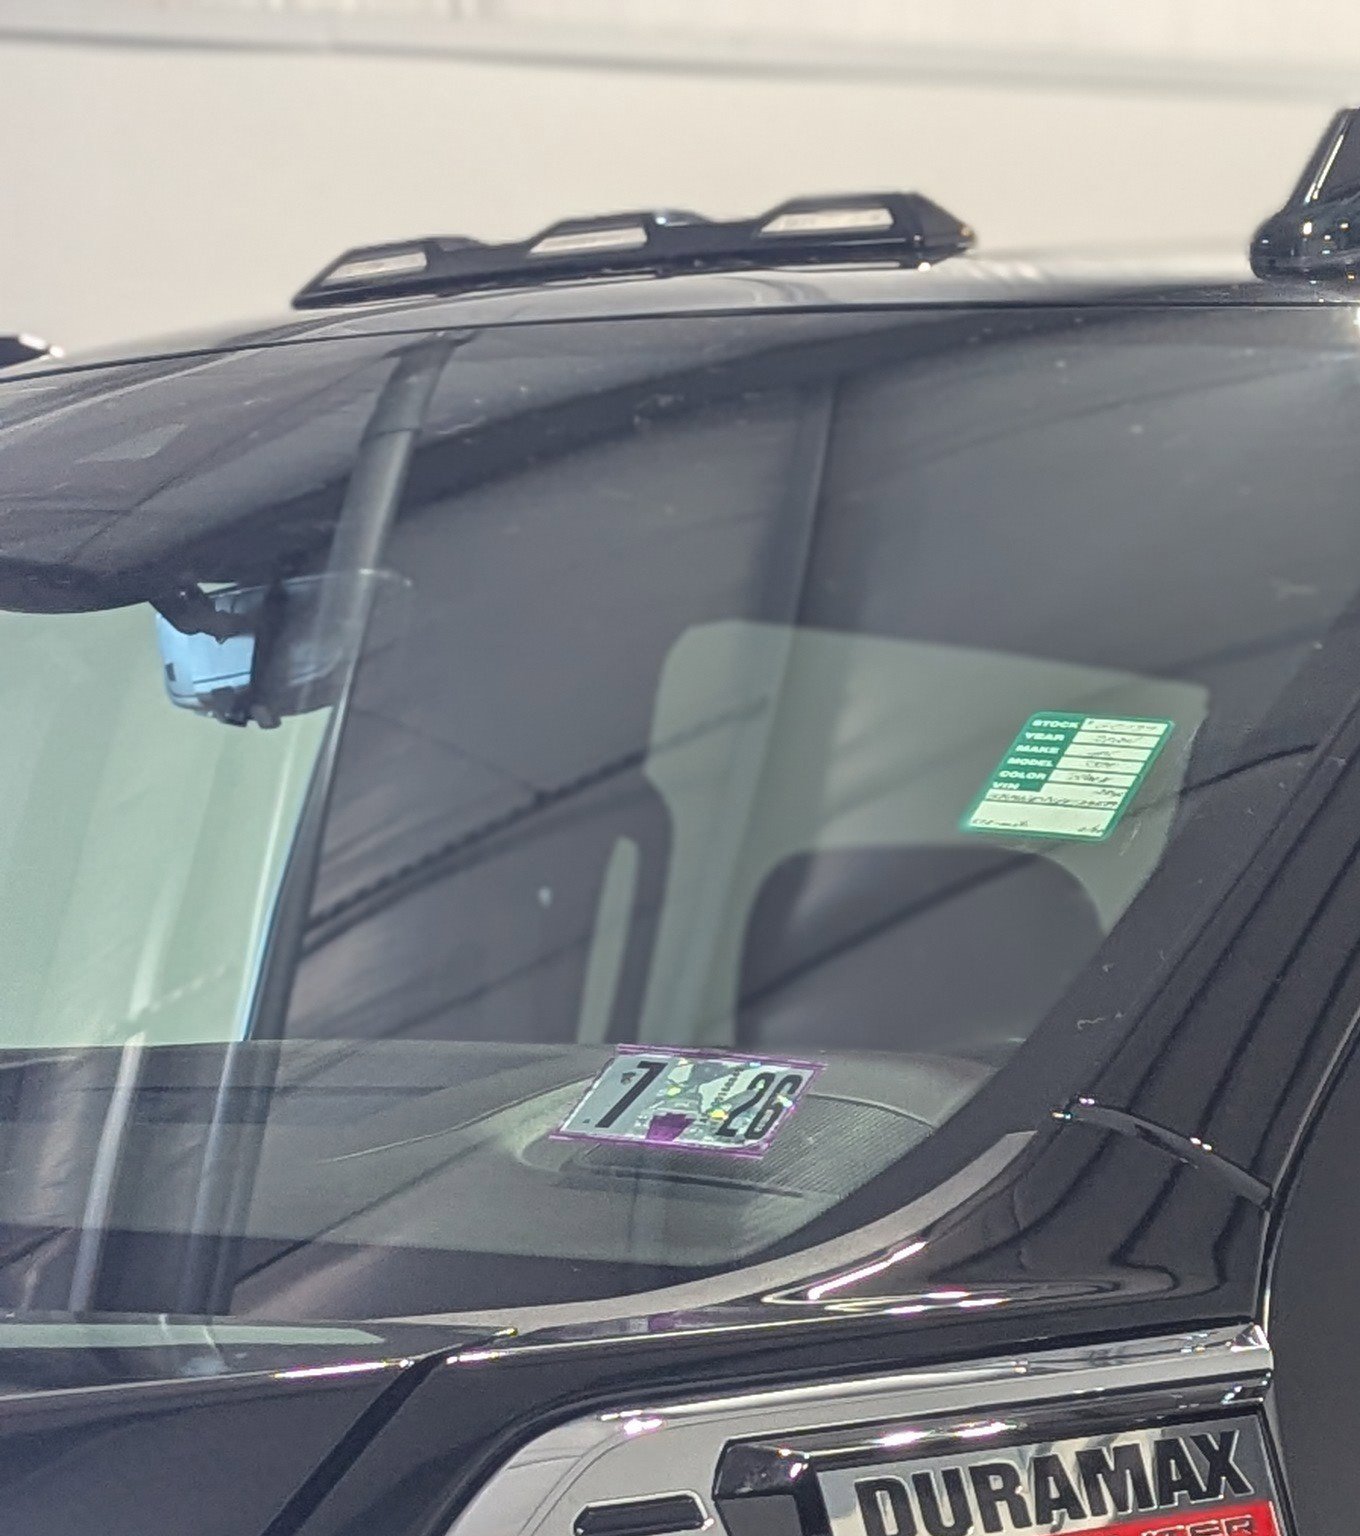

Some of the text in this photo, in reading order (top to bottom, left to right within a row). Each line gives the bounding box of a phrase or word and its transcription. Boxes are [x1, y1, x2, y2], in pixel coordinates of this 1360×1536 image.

[1032, 719, 1080, 729] STOCK
[1025, 732, 1065, 741] YEAR
[1015, 745, 1060, 754] MAKE
[1006, 757, 1054, 767] MODEL
[999, 770, 1047, 780] COLOR
[993, 782, 1020, 790] VIN
[595, 1061, 668, 1127] 7
[715, 1072, 803, 1140] 26
